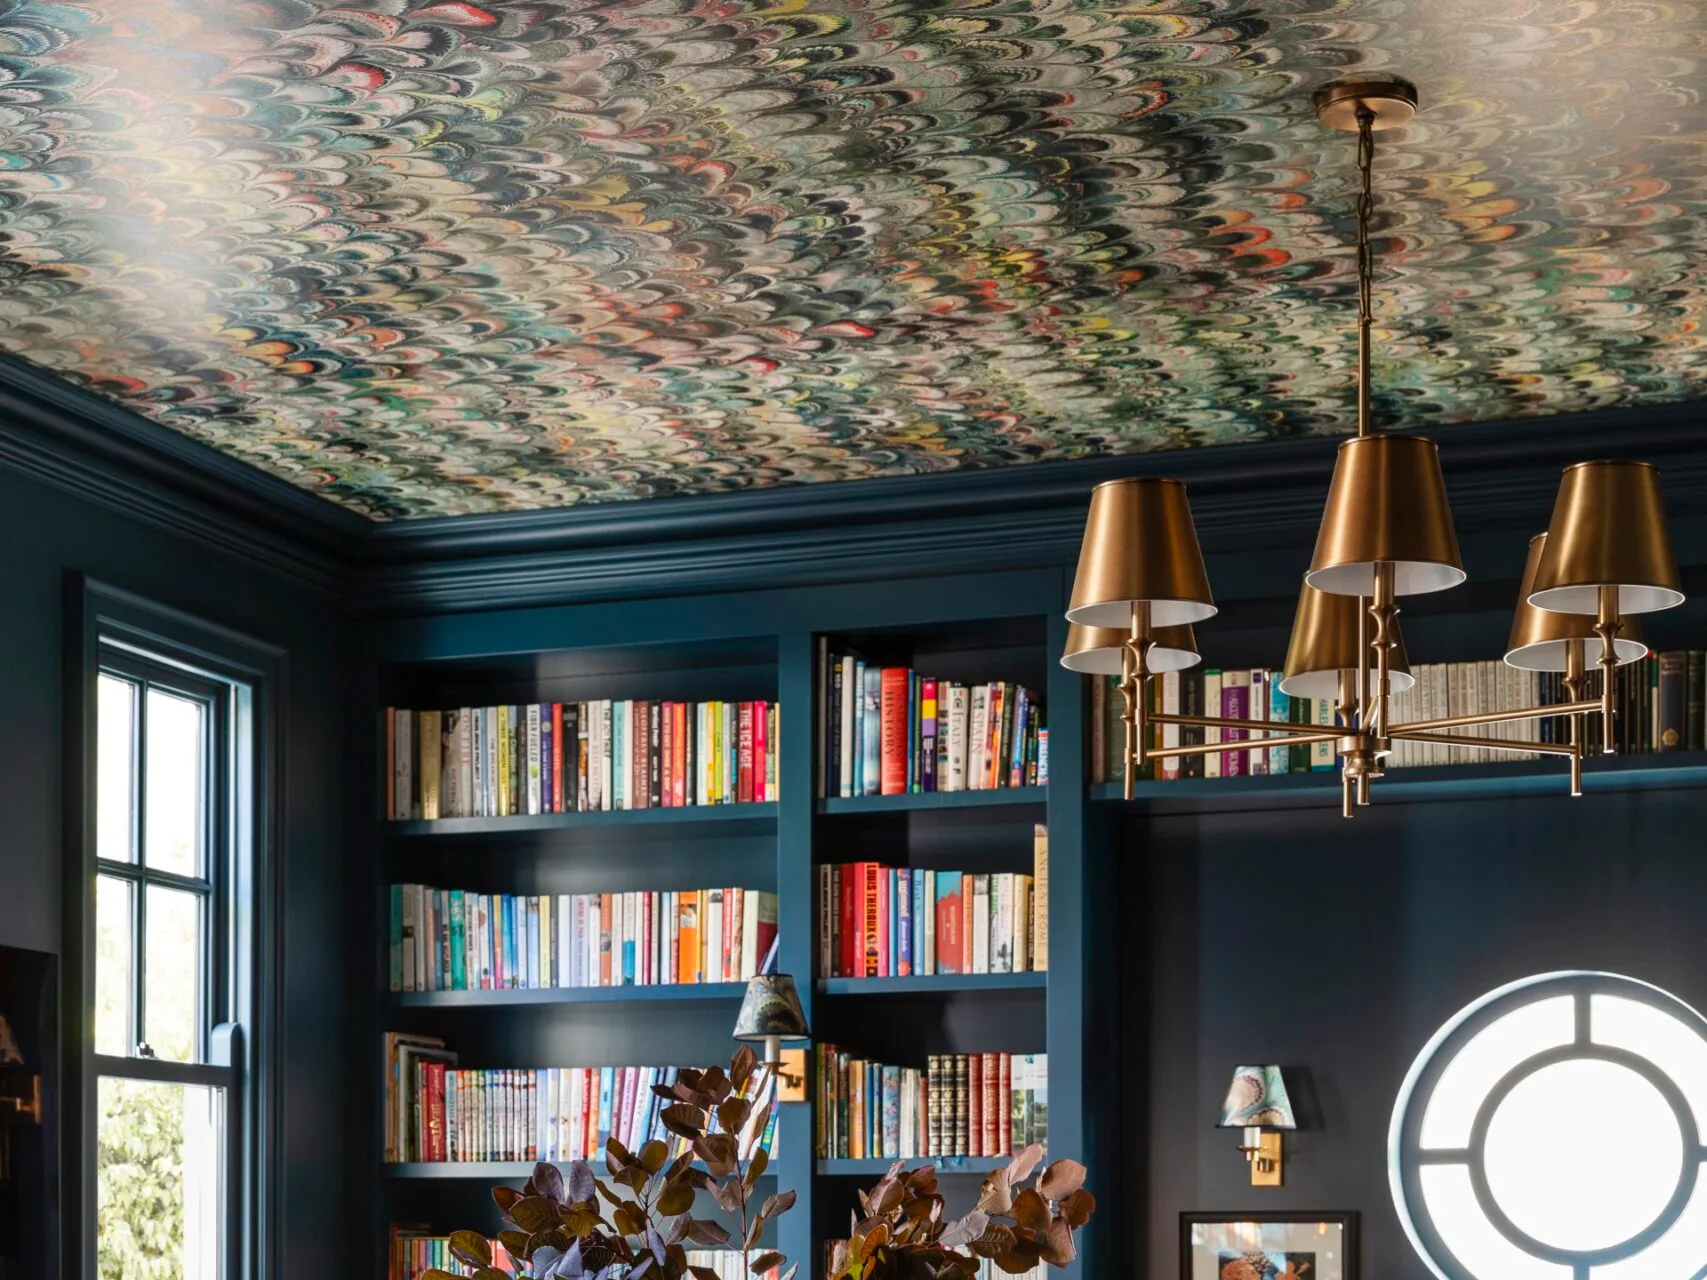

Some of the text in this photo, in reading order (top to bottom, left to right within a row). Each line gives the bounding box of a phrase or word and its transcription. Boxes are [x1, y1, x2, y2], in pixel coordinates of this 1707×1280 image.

[639, 707, 648, 797] GEOFFREY BLAINEY
[739, 708, 752, 769] THE ICE AGE
[885, 691, 895, 756] HISTORY
[951, 712, 964, 747] ITALY
[971, 712, 985, 755] SPAIN
[867, 865, 878, 932] LOUIS THEROUX
[1038, 848, 1048, 949] ANCIENT ROME
